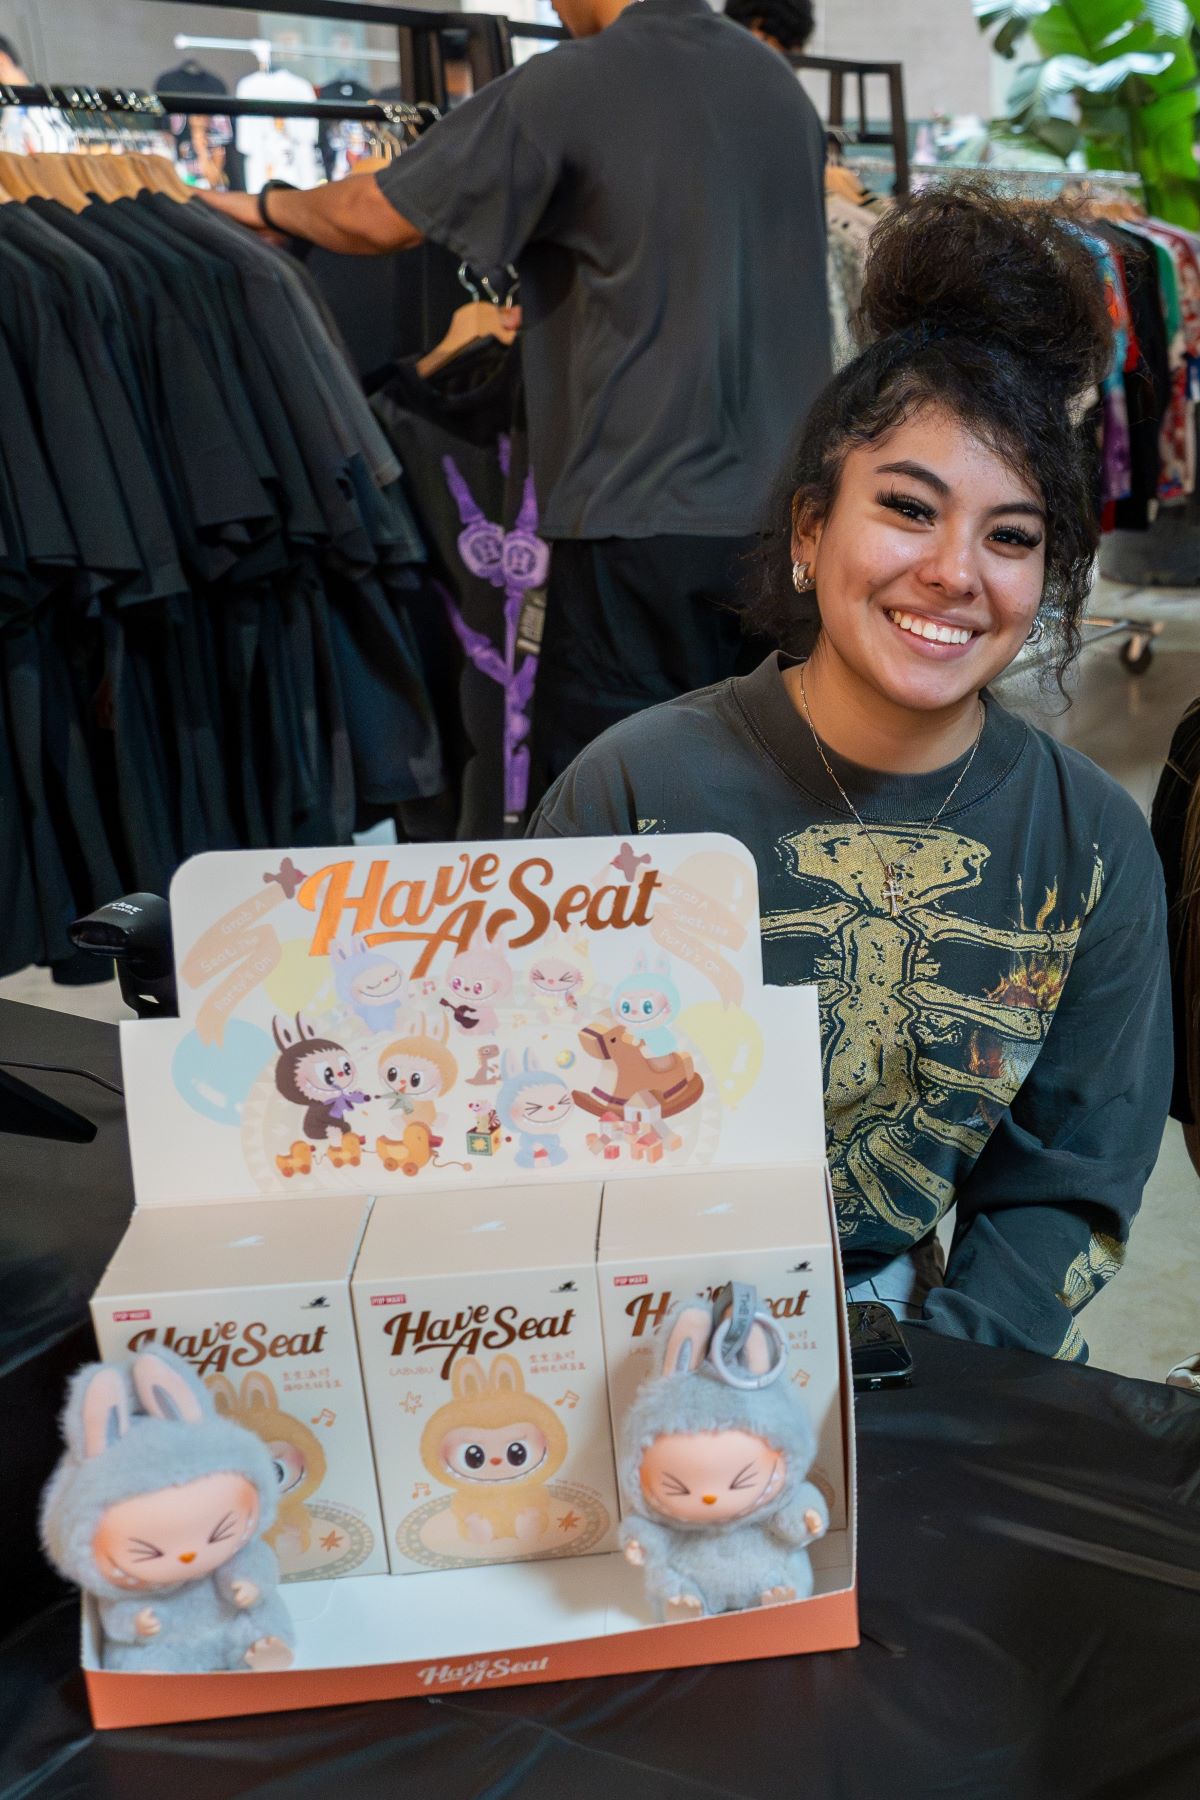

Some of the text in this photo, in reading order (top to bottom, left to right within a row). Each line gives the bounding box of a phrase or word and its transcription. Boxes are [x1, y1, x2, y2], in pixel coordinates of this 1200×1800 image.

[296, 853, 501, 957] Have
[485, 857, 663, 950] Seat
[231, 1321, 329, 1368] Seat
[383, 1305, 490, 1356] Have
[482, 1306, 577, 1350] Seat
